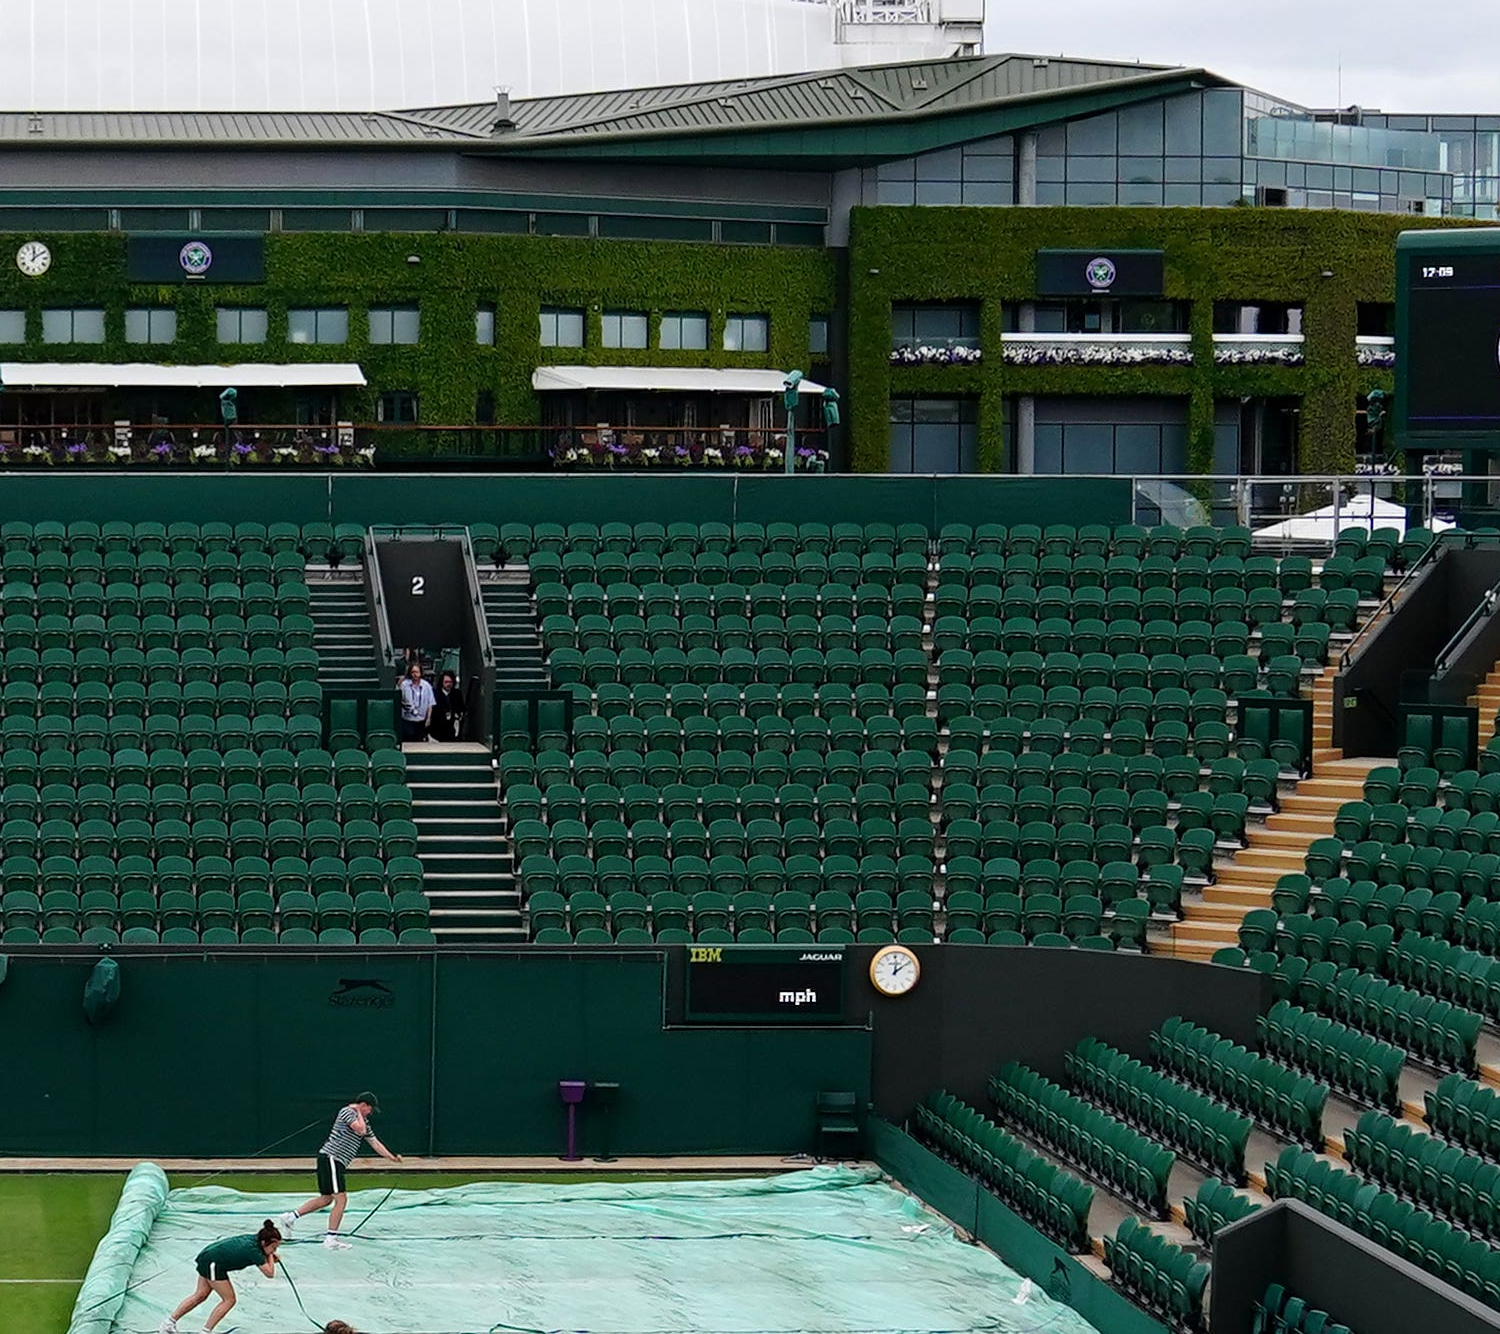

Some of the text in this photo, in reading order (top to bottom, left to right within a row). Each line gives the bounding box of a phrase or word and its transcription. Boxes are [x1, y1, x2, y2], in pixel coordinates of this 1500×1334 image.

[411, 575, 425, 595] 2
[690, 948, 722, 963] IBM
[799, 953, 843, 962] JAGUAR
[778, 988, 817, 1006] mph
